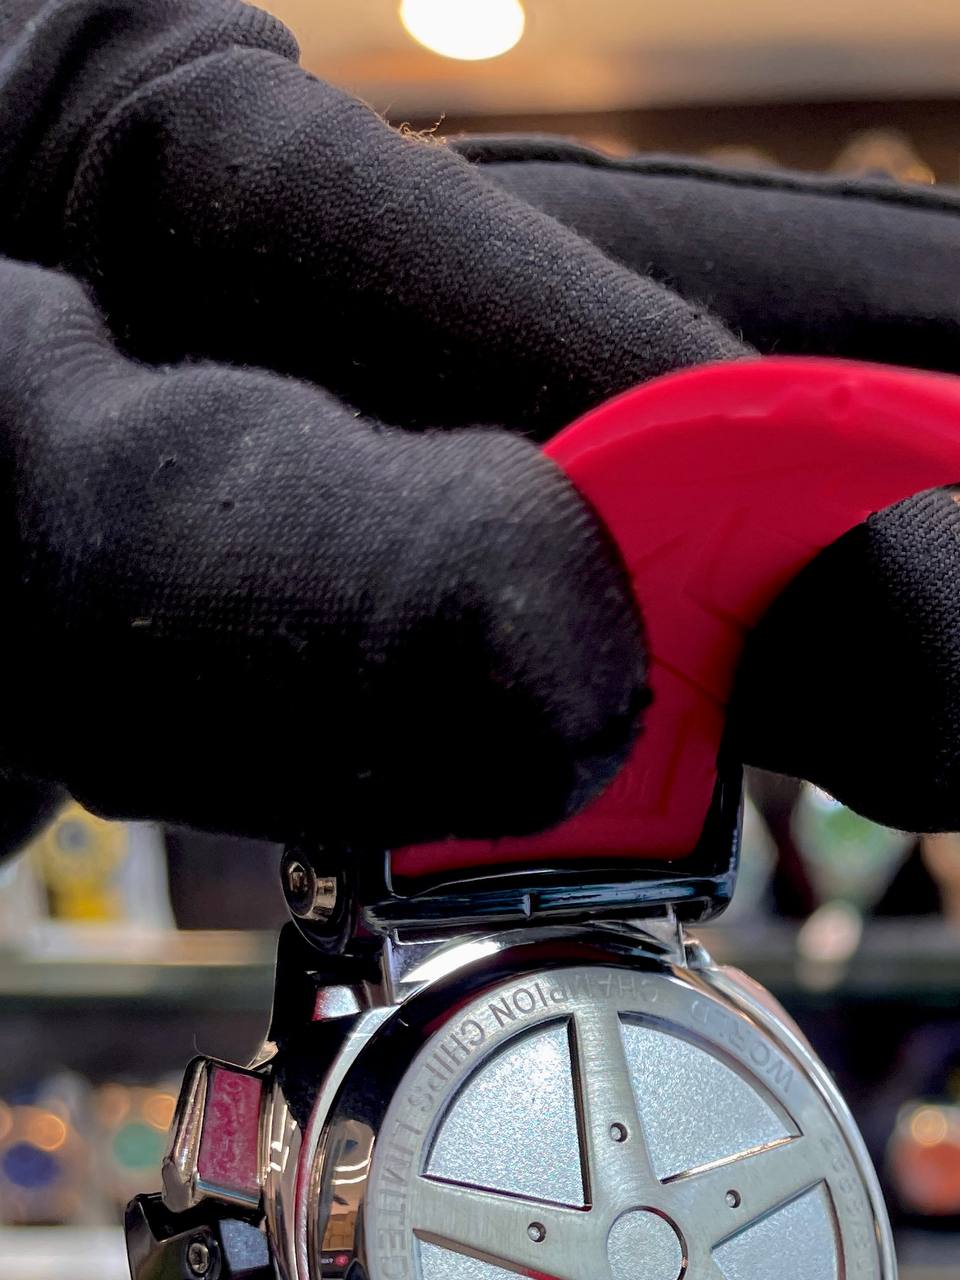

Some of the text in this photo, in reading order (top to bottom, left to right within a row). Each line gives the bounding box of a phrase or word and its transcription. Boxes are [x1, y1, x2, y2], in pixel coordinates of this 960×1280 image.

[486, 972, 658, 1028] CHAMPION
[690, 998, 797, 1095] WORLD
[378, 1116, 421, 1280] LIMITED
